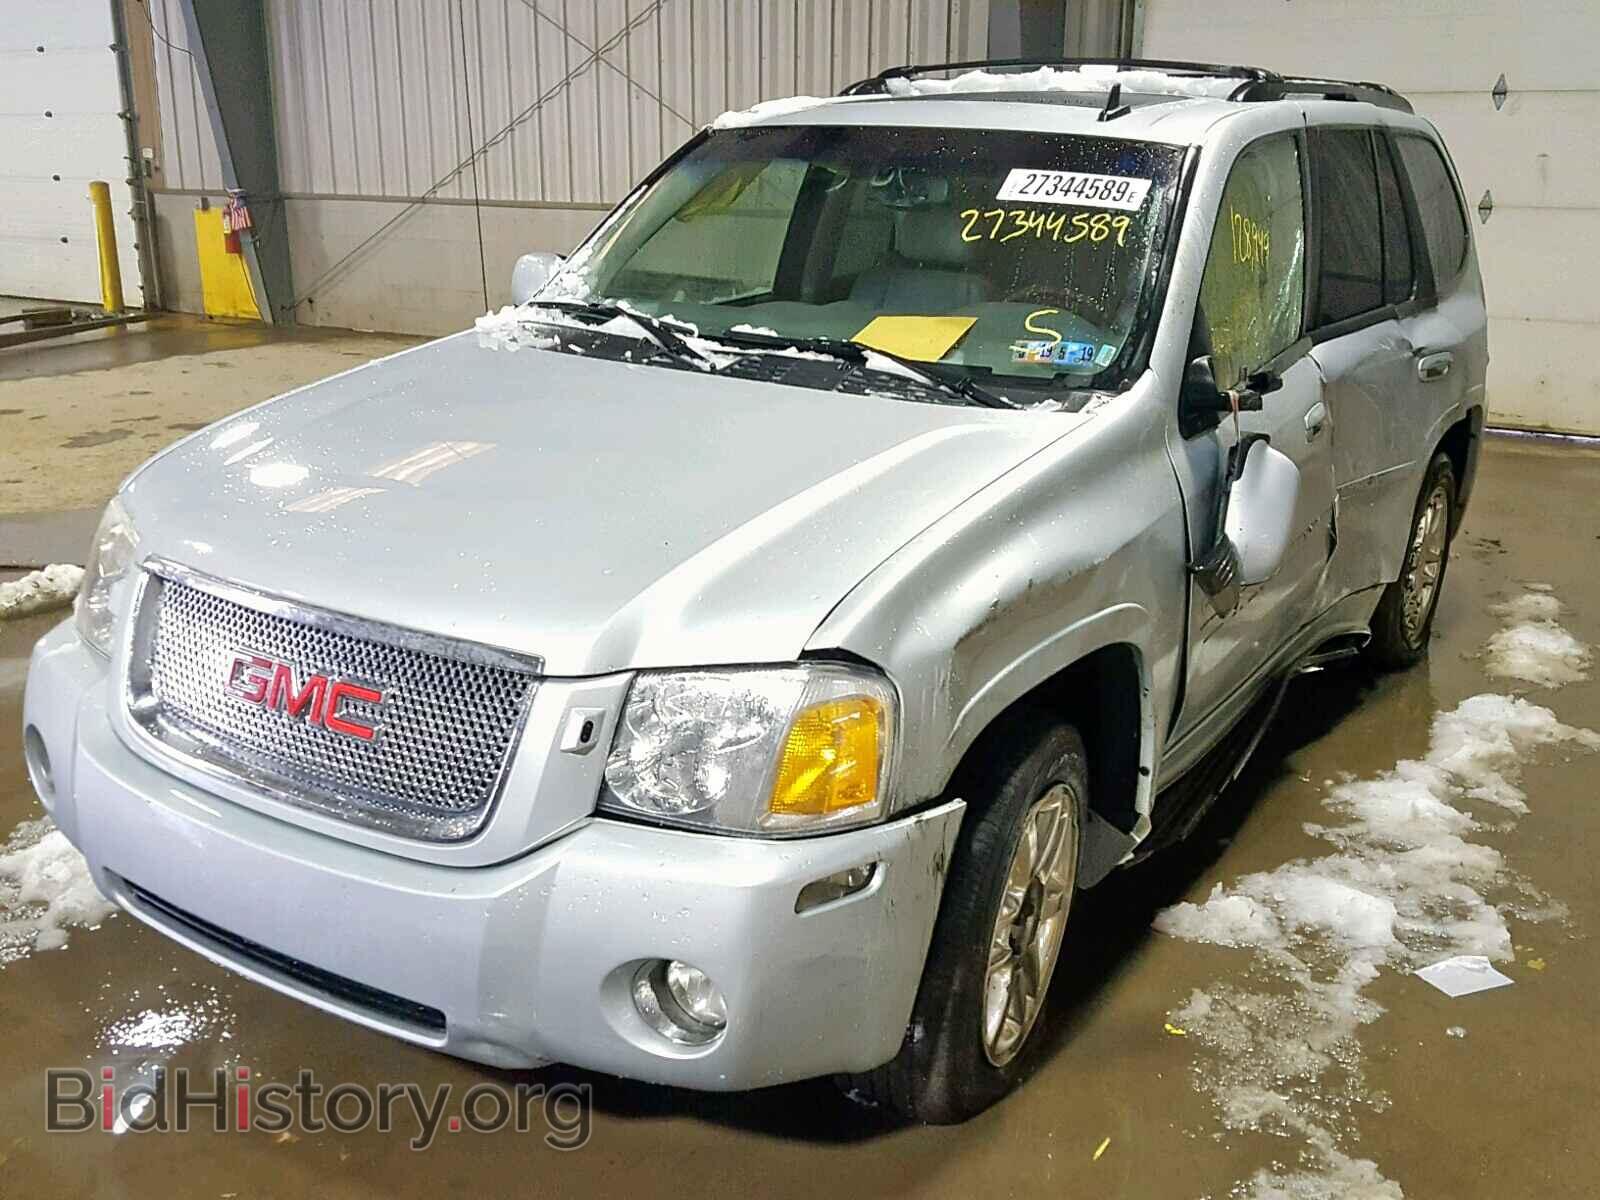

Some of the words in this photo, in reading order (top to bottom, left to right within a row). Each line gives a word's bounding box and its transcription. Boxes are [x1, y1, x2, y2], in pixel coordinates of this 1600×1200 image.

[1018, 173, 1130, 202] 27344589
[960, 208, 1131, 247] 27344589
[1081, 346, 1094, 361] 19
[227, 652, 383, 741] GMC
